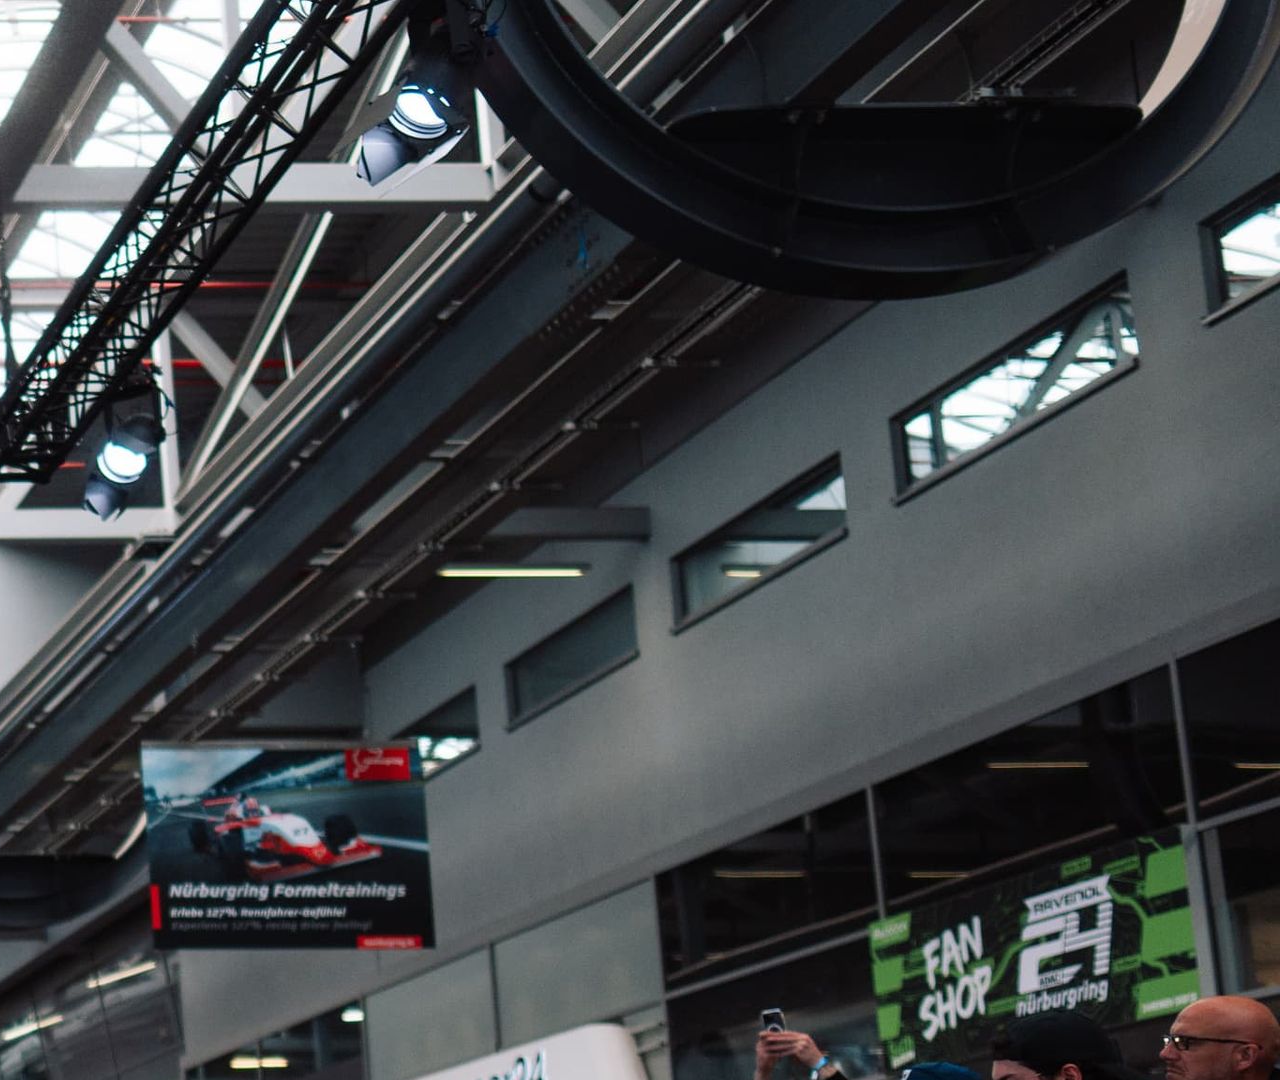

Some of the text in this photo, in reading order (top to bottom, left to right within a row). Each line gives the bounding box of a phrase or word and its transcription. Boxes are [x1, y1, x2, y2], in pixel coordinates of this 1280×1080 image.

[170, 882, 407, 900] Nürburgring Formeltrainings
[923, 915, 984, 990] FAN
[919, 965, 992, 1042] SHOP
[1015, 979, 1110, 1018] nürburgring
